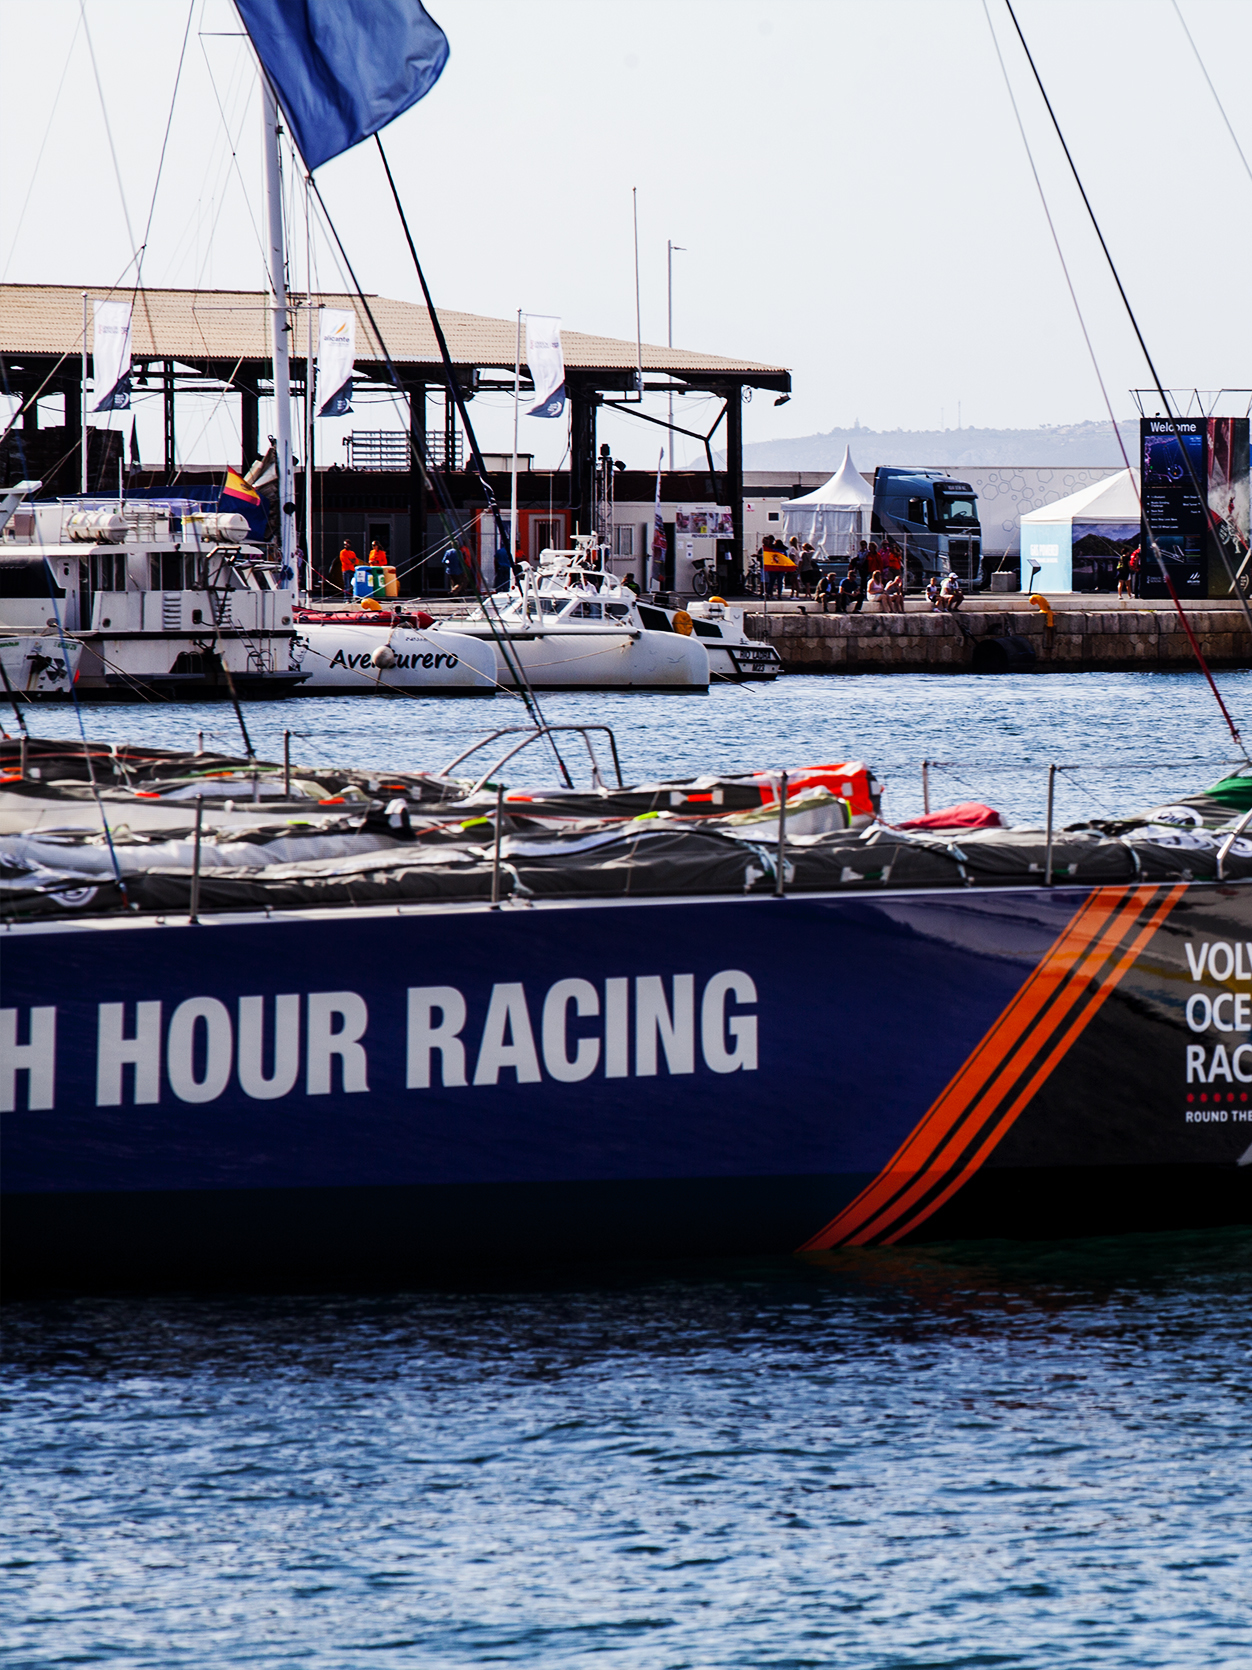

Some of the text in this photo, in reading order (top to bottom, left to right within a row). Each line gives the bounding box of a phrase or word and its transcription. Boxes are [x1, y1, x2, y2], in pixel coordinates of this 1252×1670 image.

[323, 334, 351, 343] alicante
[329, 649, 459, 669] Aveurero
[96, 991, 370, 1107] HOUR
[406, 970, 759, 1090] RACING
[1185, 1110, 1229, 1123] ROUND
